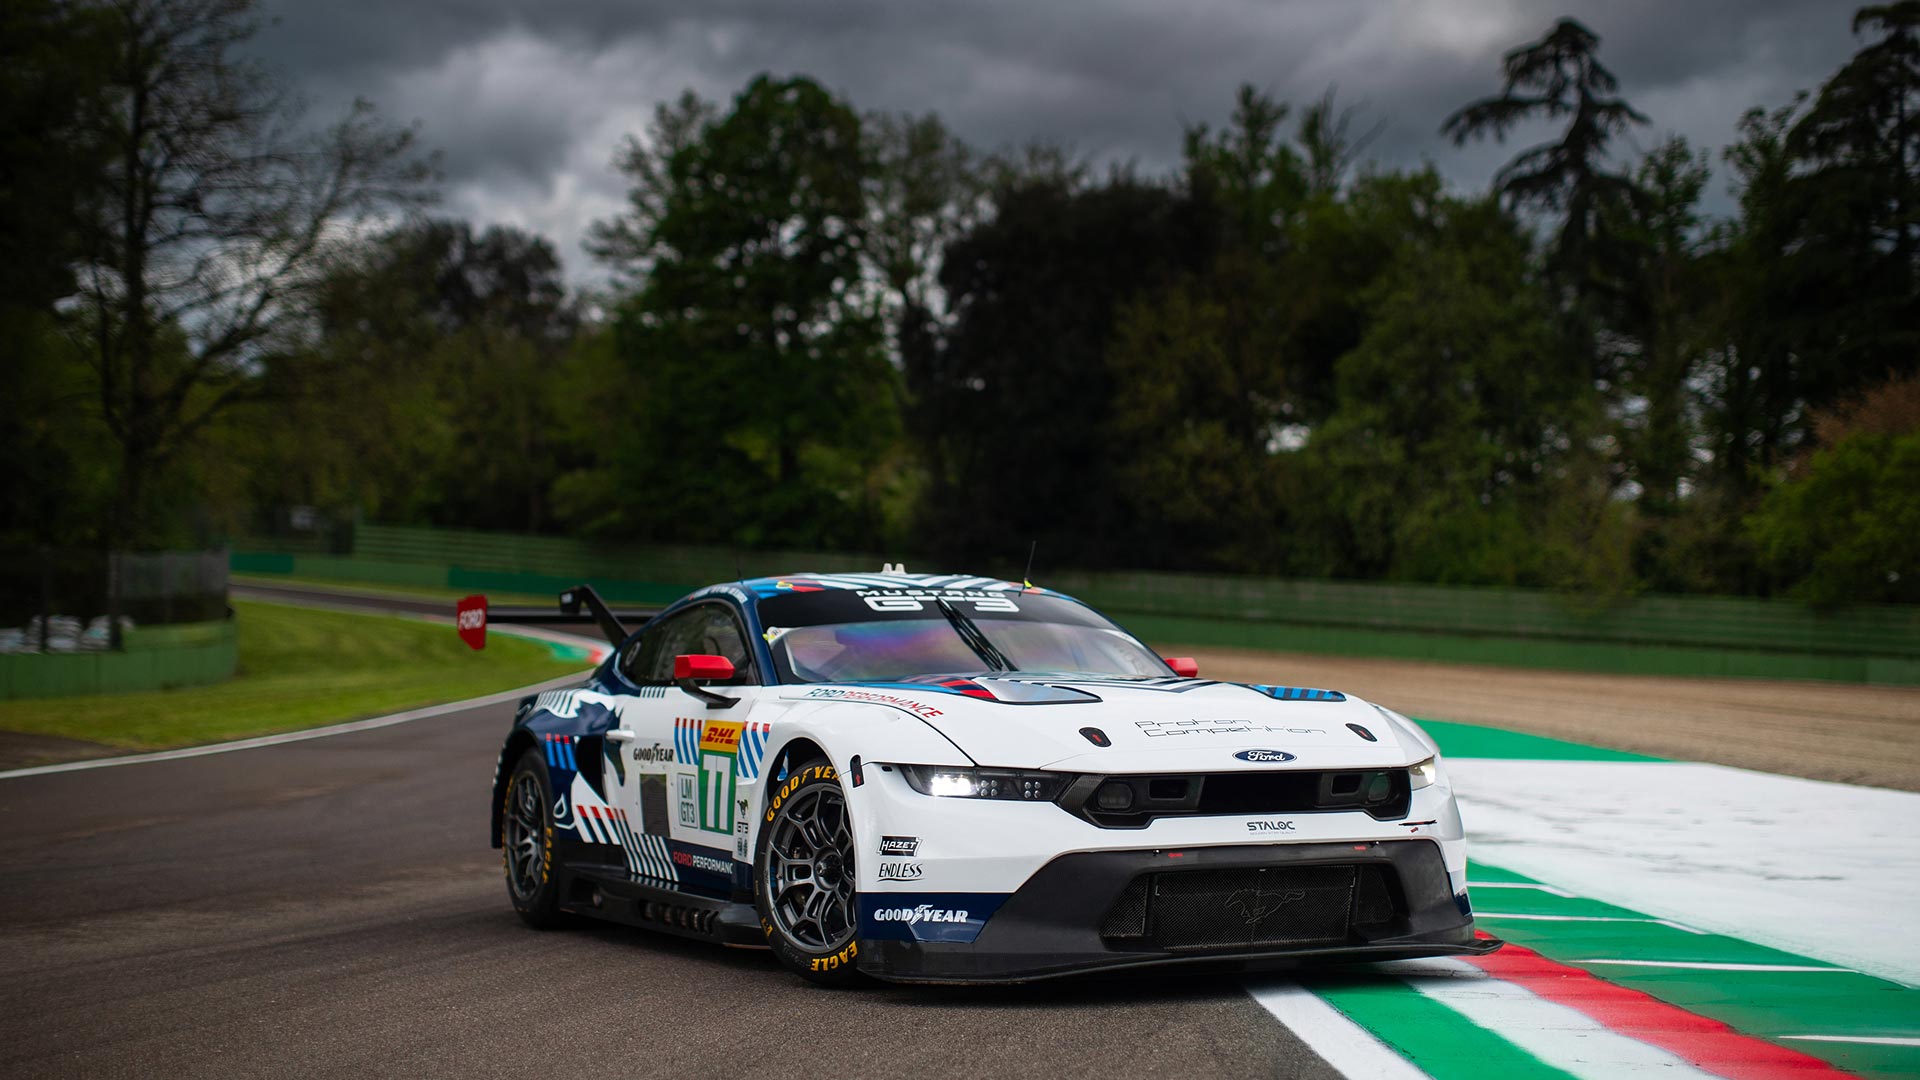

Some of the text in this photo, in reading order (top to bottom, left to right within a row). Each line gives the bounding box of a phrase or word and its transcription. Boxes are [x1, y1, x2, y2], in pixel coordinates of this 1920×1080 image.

[855, 590, 1006, 598] MUSTANG
[864, 596, 1020, 612] GT3
[458, 608, 485, 630] FORD
[704, 727, 735, 744] DHL
[633, 743, 674, 764] GOODYEAR
[1247, 751, 1286, 761] Ford
[681, 778, 692, 799] LM
[766, 765, 840, 822] GOODYEA
[681, 801, 695, 823] GT3
[1246, 821, 1296, 831] STALOC
[881, 841, 916, 851] HAZET
[673, 851, 733, 875] FORD PERFORMANC
[878, 863, 923, 878] ENDLESS
[874, 904, 968, 925] GOODYEAR
[810, 940, 858, 971] EAGLE
